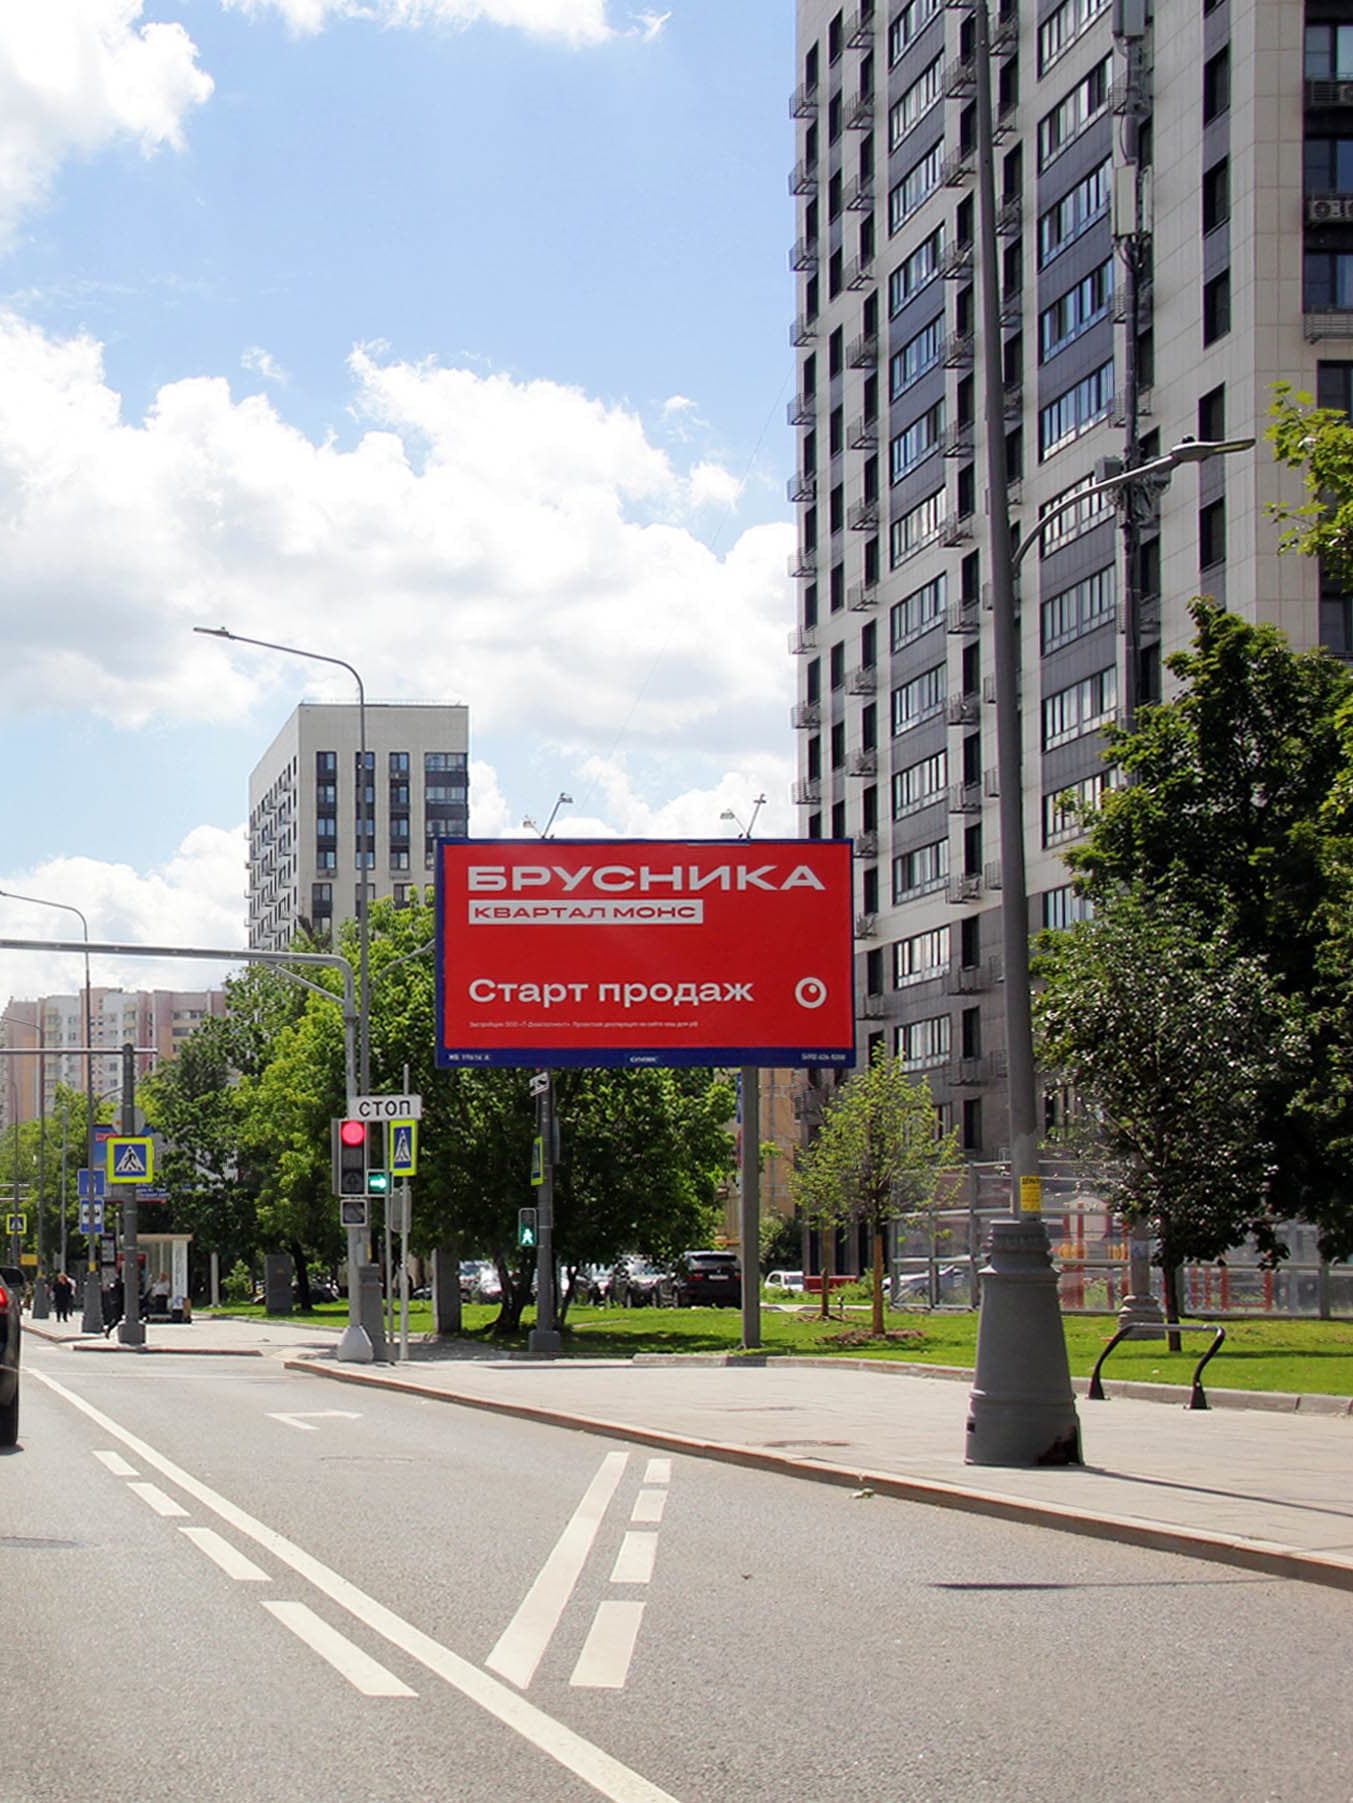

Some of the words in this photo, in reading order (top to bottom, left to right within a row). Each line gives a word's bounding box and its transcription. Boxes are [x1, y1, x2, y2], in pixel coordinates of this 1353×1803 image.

[467, 865, 826, 892] БРУСНИКА
[474, 906, 606, 919] КВАРТАЛ
[613, 906, 696, 919] МОНС
[468, 978, 589, 1008] Старт
[598, 982, 754, 1008] продаж
[358, 1100, 411, 1117] СТОП
